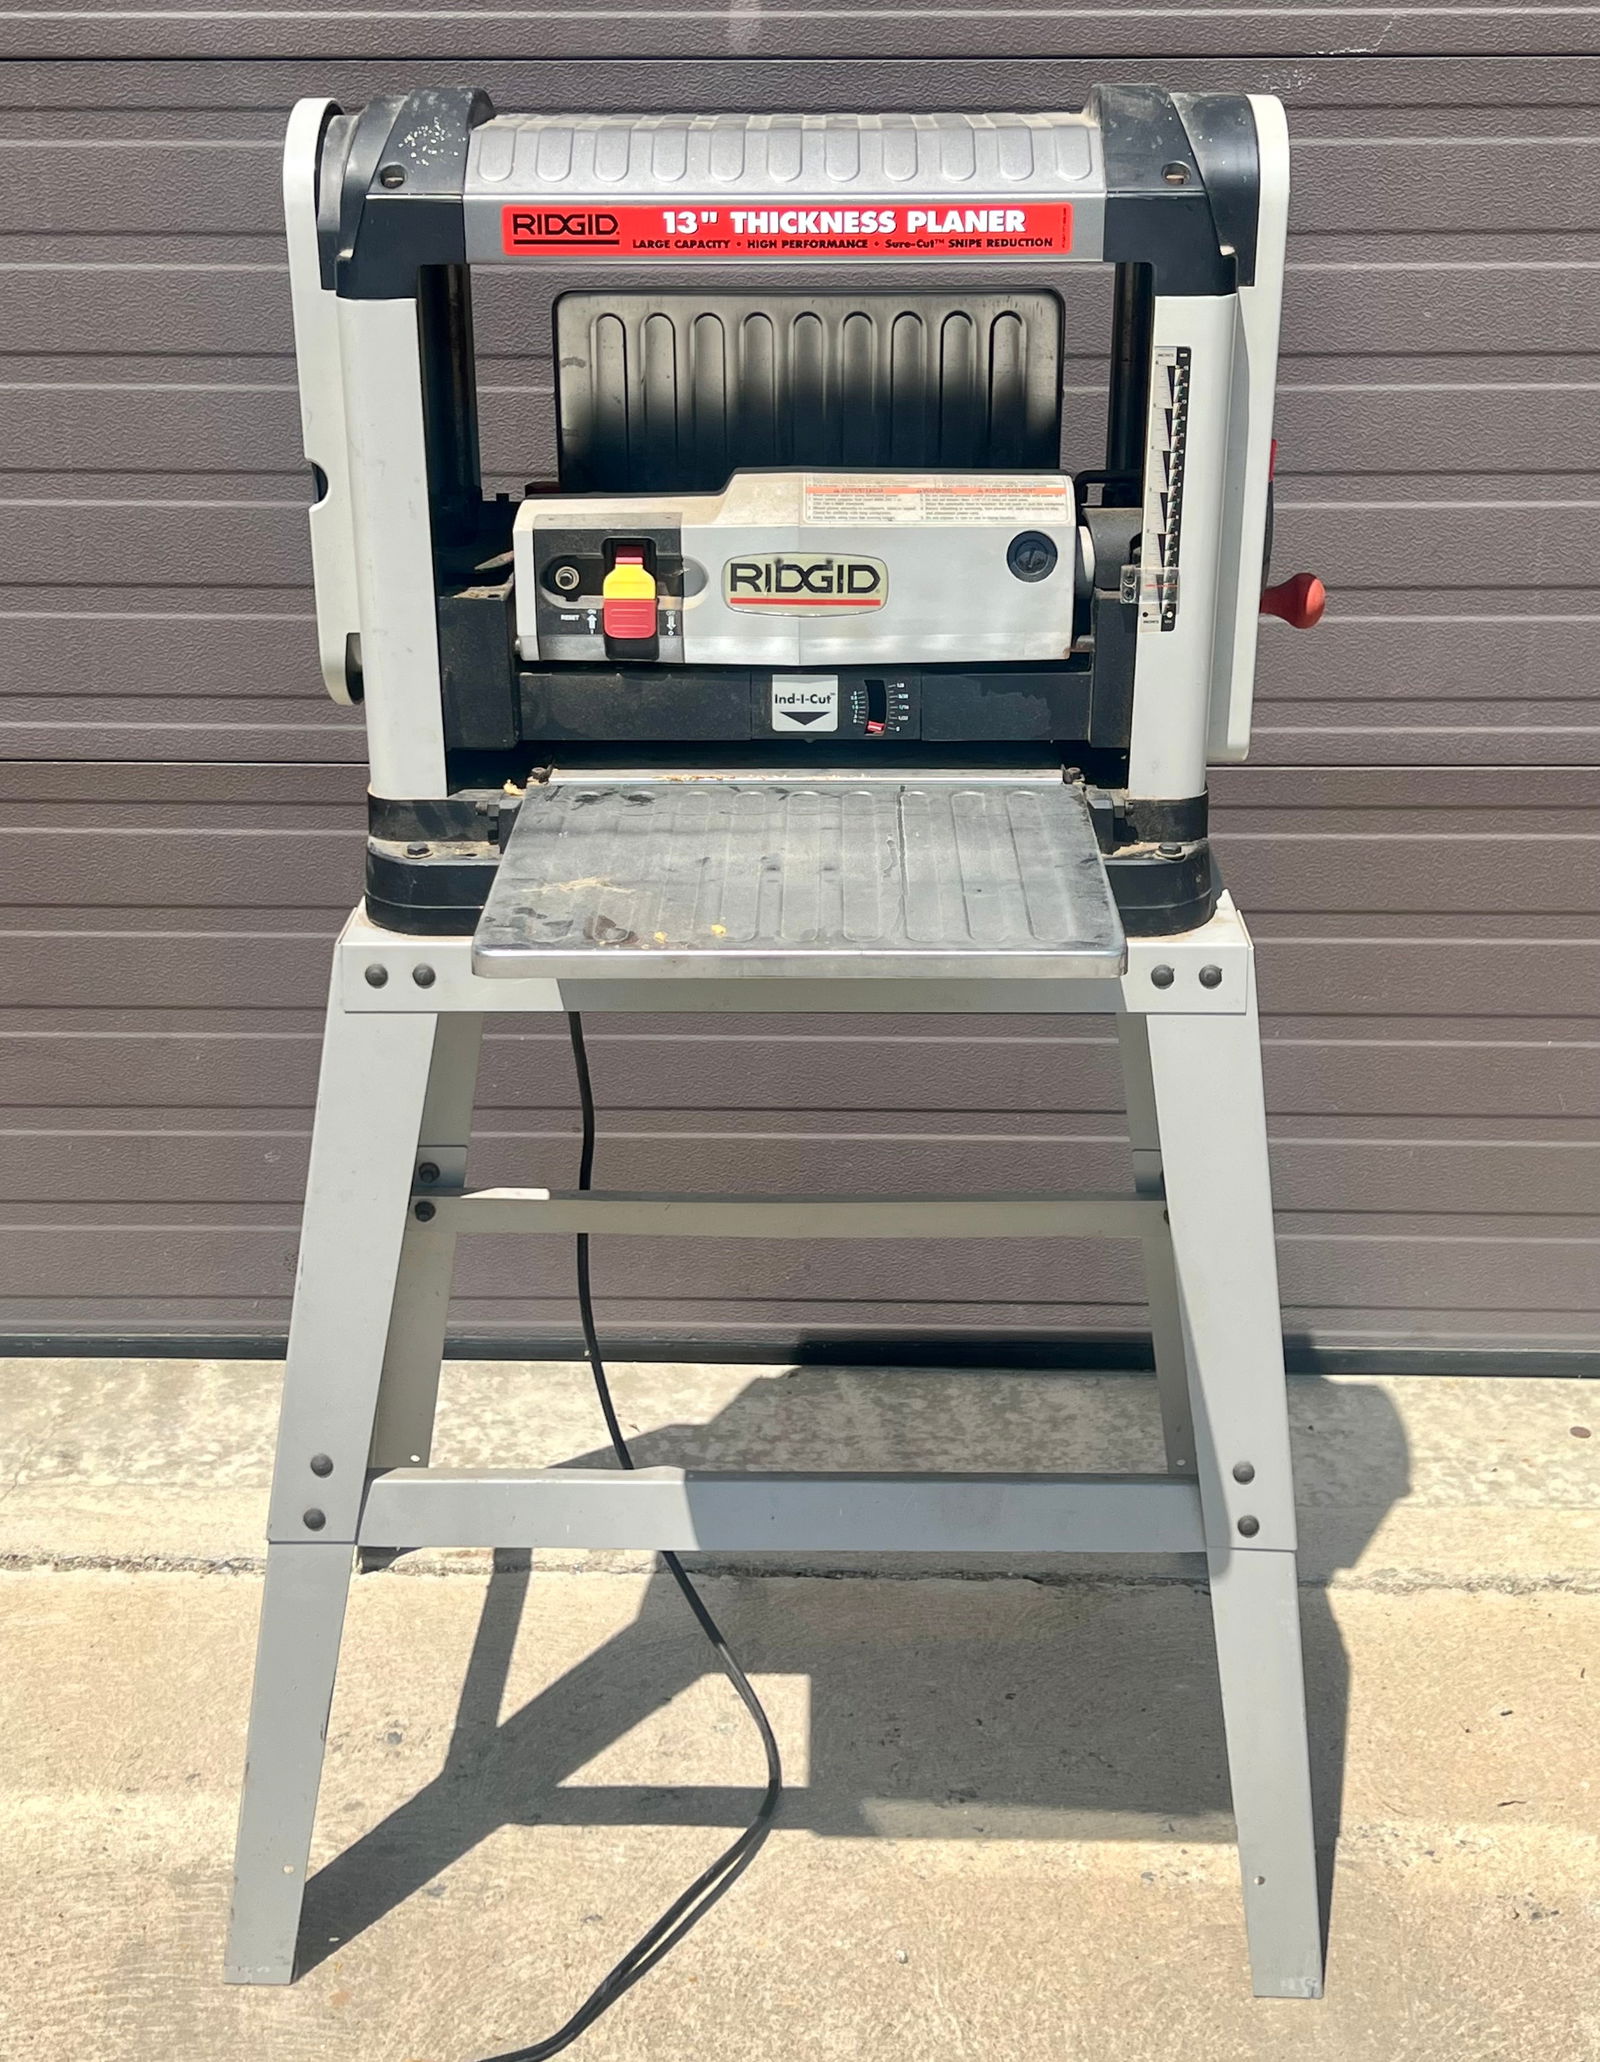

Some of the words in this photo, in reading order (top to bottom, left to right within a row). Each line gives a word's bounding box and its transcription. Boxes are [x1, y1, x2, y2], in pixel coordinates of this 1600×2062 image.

[512, 213, 620, 236] RIDGID
[663, 211, 719, 235] 13"
[730, 210, 898, 235] THICKNESS
[907, 210, 1027, 234] PLANER
[632, 239, 671, 250] LARGE
[674, 239, 731, 250] CAPACITY
[747, 239, 778, 250] HIGH
[781, 238, 869, 250] PERFORMANCE
[948, 238, 983, 249] SNIPE
[986, 237, 1054, 248] REDUCTION
[730, 563, 881, 594] RIDGID
